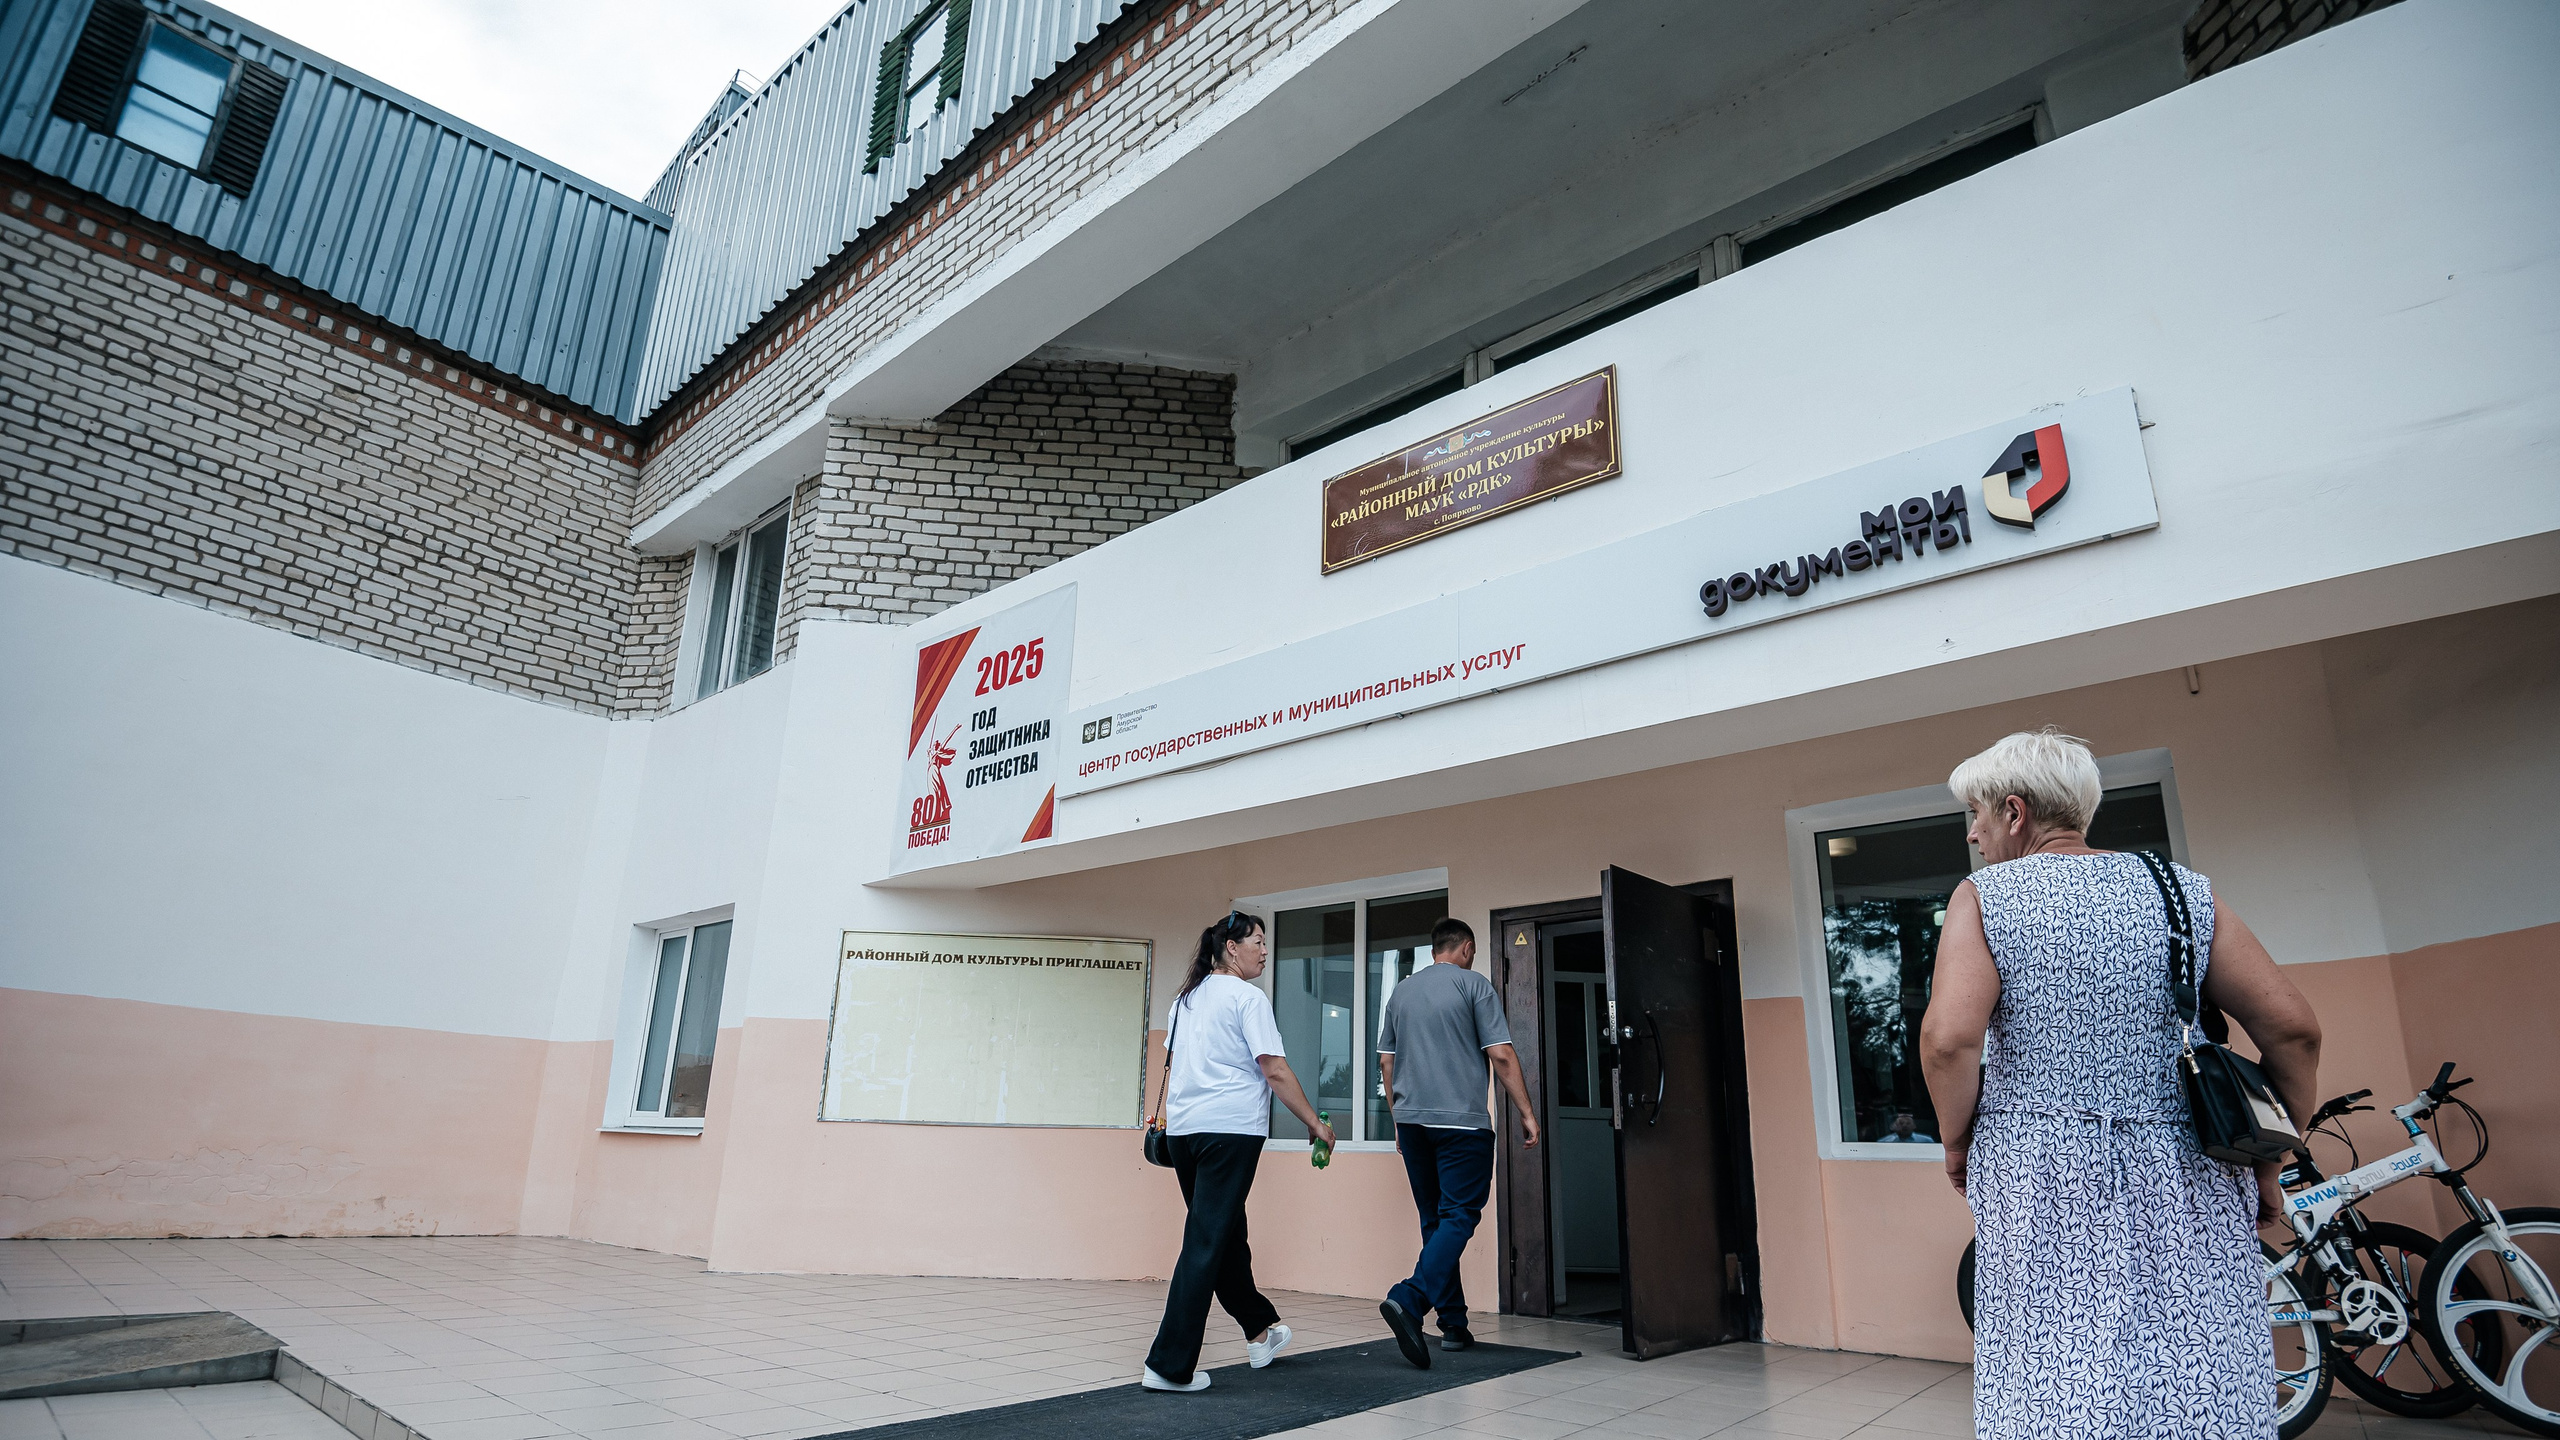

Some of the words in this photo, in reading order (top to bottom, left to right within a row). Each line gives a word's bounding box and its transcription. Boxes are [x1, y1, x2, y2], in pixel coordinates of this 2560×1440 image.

[1359, 468, 1420, 497] Муниципальное
[1420, 450, 1468, 472] автономное
[1469, 429, 1522, 456] учреждение
[1523, 412, 1566, 433] культуры
[1331, 474, 1437, 529] «РАЙОННЫЙ
[1440, 460, 1483, 492] ДОМ
[1487, 419, 1605, 472] КУЛЬТУРЫ»
[1405, 491, 1454, 521] МАУК
[1458, 473, 1512, 501] «РДК»
[1441, 503, 1482, 523] Поярково
[975, 637, 1044, 697] 2025
[971, 706, 997, 732] ГОД
[1078, 753, 1121, 777] центр
[1124, 711, 1268, 760] государственных
[1272, 709, 1283, 724] и
[1288, 661, 1456, 724] муниципальных
[1461, 642, 1526, 680] услуг
[1116, 703, 1158, 720] Правительство
[1116, 714, 1143, 728] Амурской
[968, 718, 1051, 761] ЗАЩИТНИКА
[1115, 724, 1138, 735] области
[965, 751, 1039, 789] ОТЕЧЕСТВА
[908, 825, 951, 850] ПОБЕДА!
[846, 948, 930, 964] РАЙОННЫЙ
[931, 953, 964, 966] ДОМ
[967, 954, 1043, 968] КУЛЬТУРЫ
[1045, 956, 1143, 971] ПРИГЛАШАЕТ
[2293, 1185, 2339, 1210] BMW
[2272, 1311, 2312, 1321] BMW
